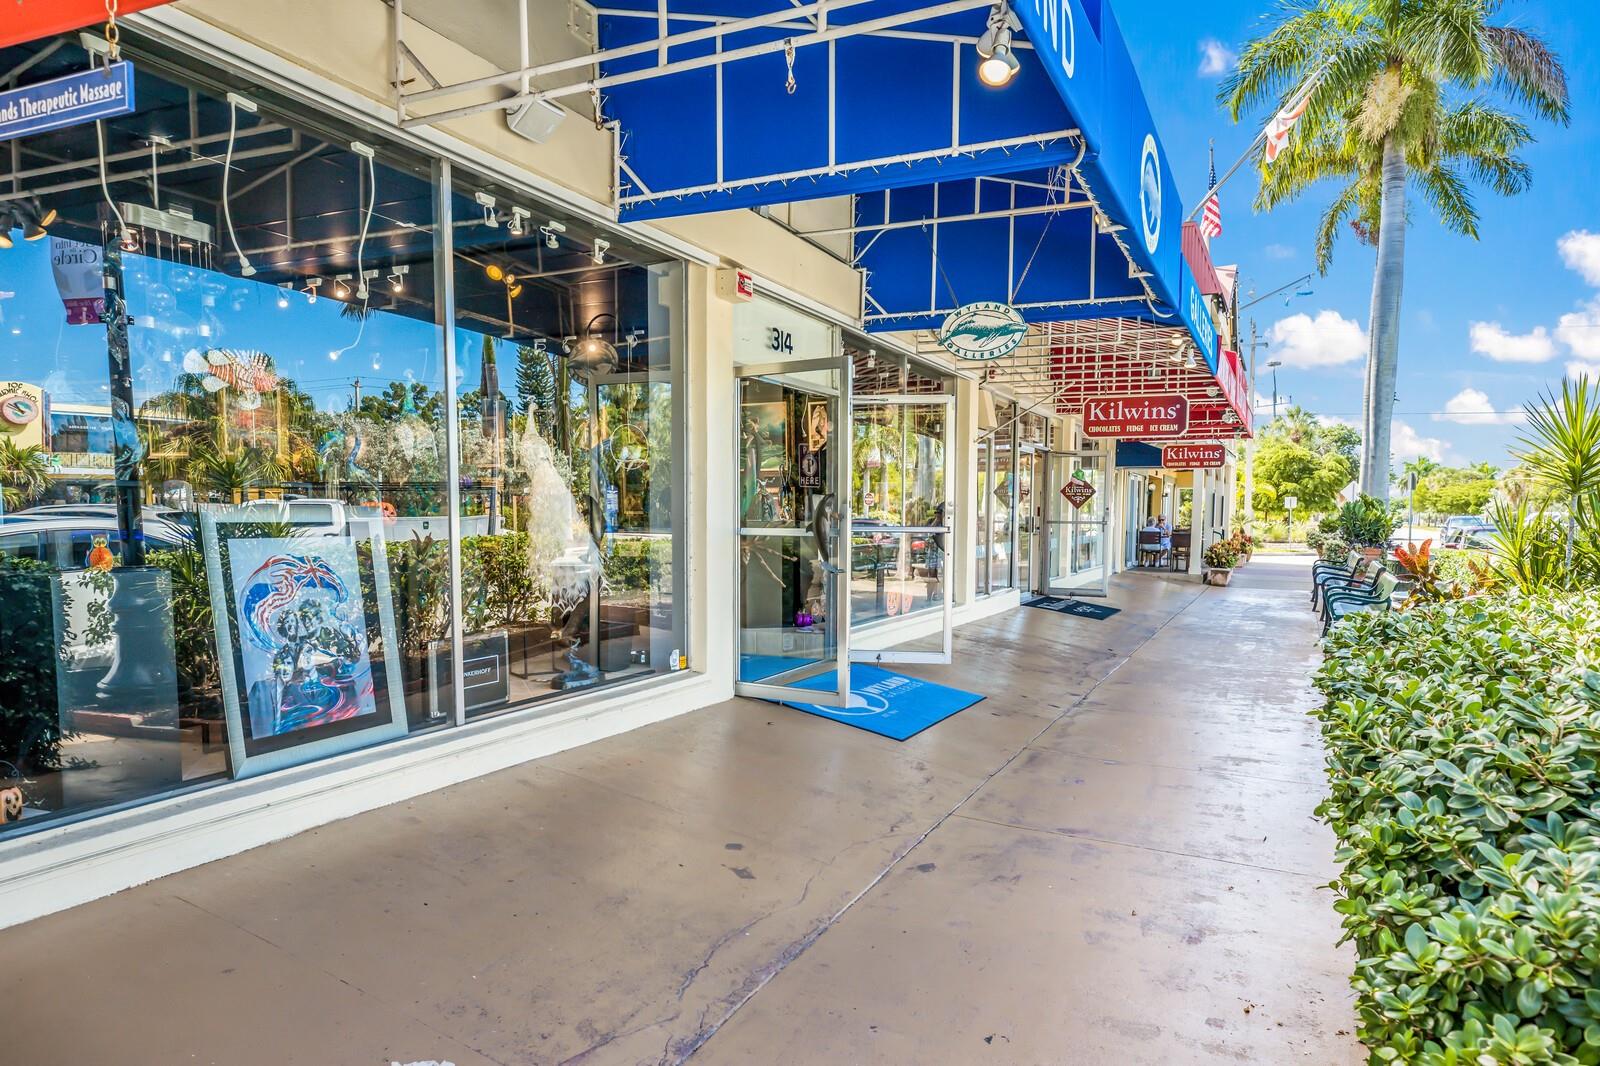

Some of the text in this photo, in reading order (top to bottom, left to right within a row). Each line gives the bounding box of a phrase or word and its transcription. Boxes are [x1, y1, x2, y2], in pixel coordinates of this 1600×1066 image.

[1034, 0, 1074, 79] ND
[19, 86, 78, 116] Therapeutic
[80, 80, 122, 103] Massage
[954, 303, 1010, 318] WYLAND
[772, 327, 793, 355] 314
[947, 339, 1018, 359] GALLERIES
[1089, 400, 1177, 421] Kilwins
[1088, 424, 1178, 433] CHOCOLATES FUDGE ICE CREAM
[1167, 448, 1220, 460] Kilwins
[800, 476, 819, 485] HERE
[1065, 485, 1093, 493] Kilwins
